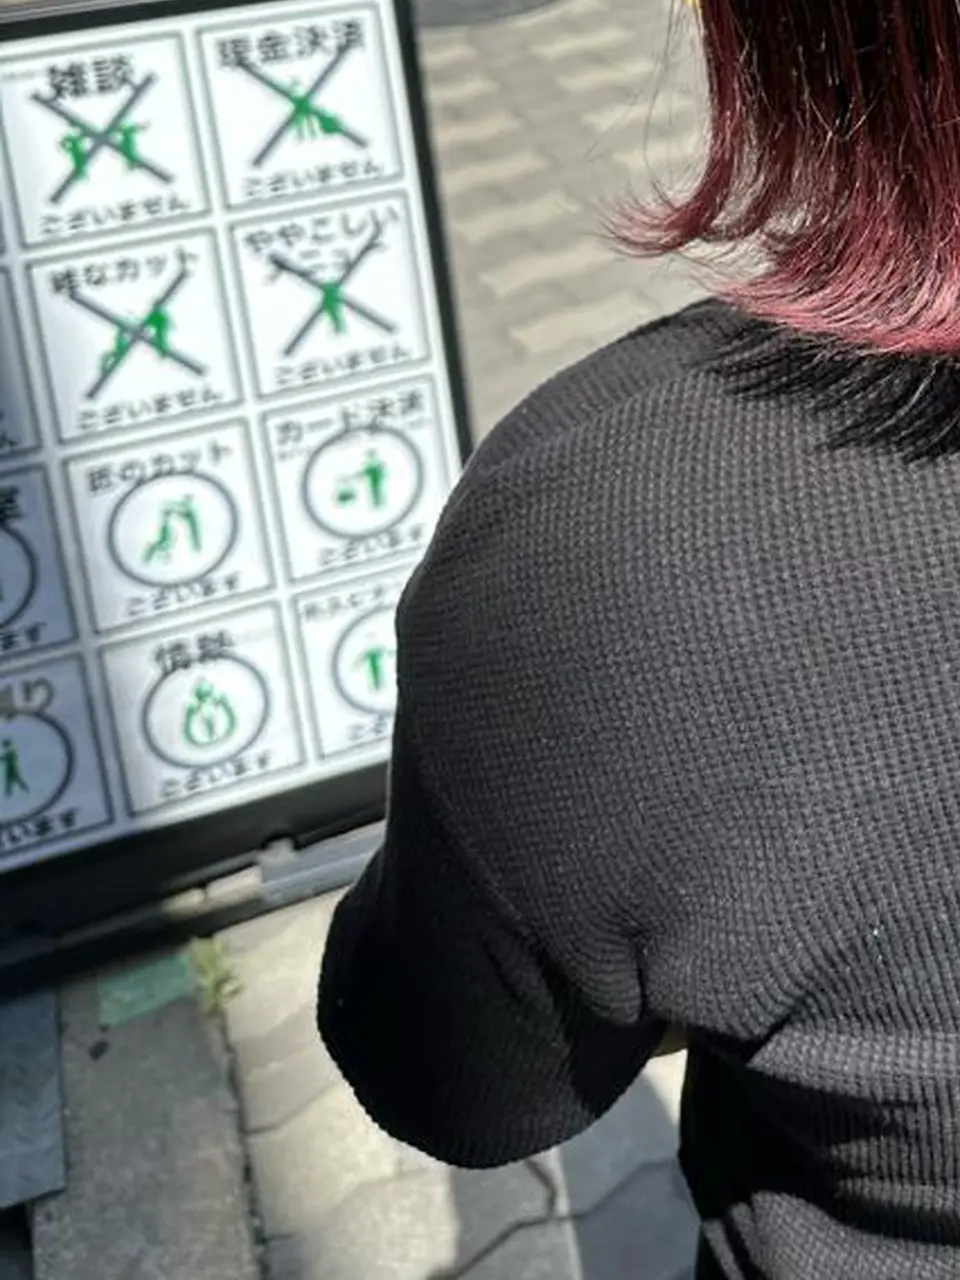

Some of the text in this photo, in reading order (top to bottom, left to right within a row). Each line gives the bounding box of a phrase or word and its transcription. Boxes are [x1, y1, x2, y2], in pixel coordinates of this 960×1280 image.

[40, 195, 190, 234] ございません
[78, 385, 223, 430] ございません
